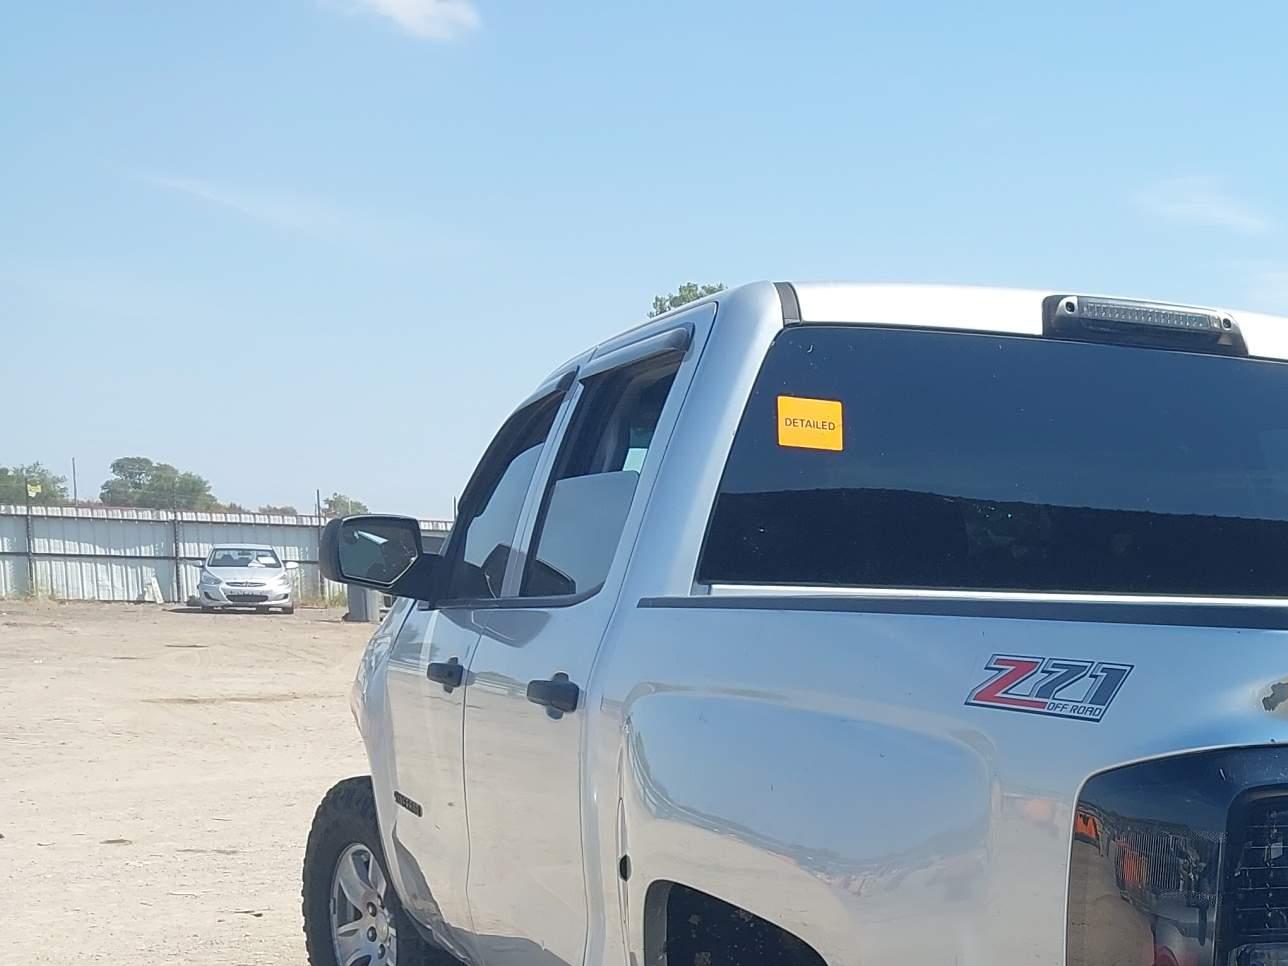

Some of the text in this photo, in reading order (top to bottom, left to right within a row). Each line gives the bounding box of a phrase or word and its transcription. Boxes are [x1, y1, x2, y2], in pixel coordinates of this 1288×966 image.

[784, 417, 836, 431] DETAILED
[964, 653, 1135, 723] Z71
[1046, 702, 1103, 717] OFF ROAD
